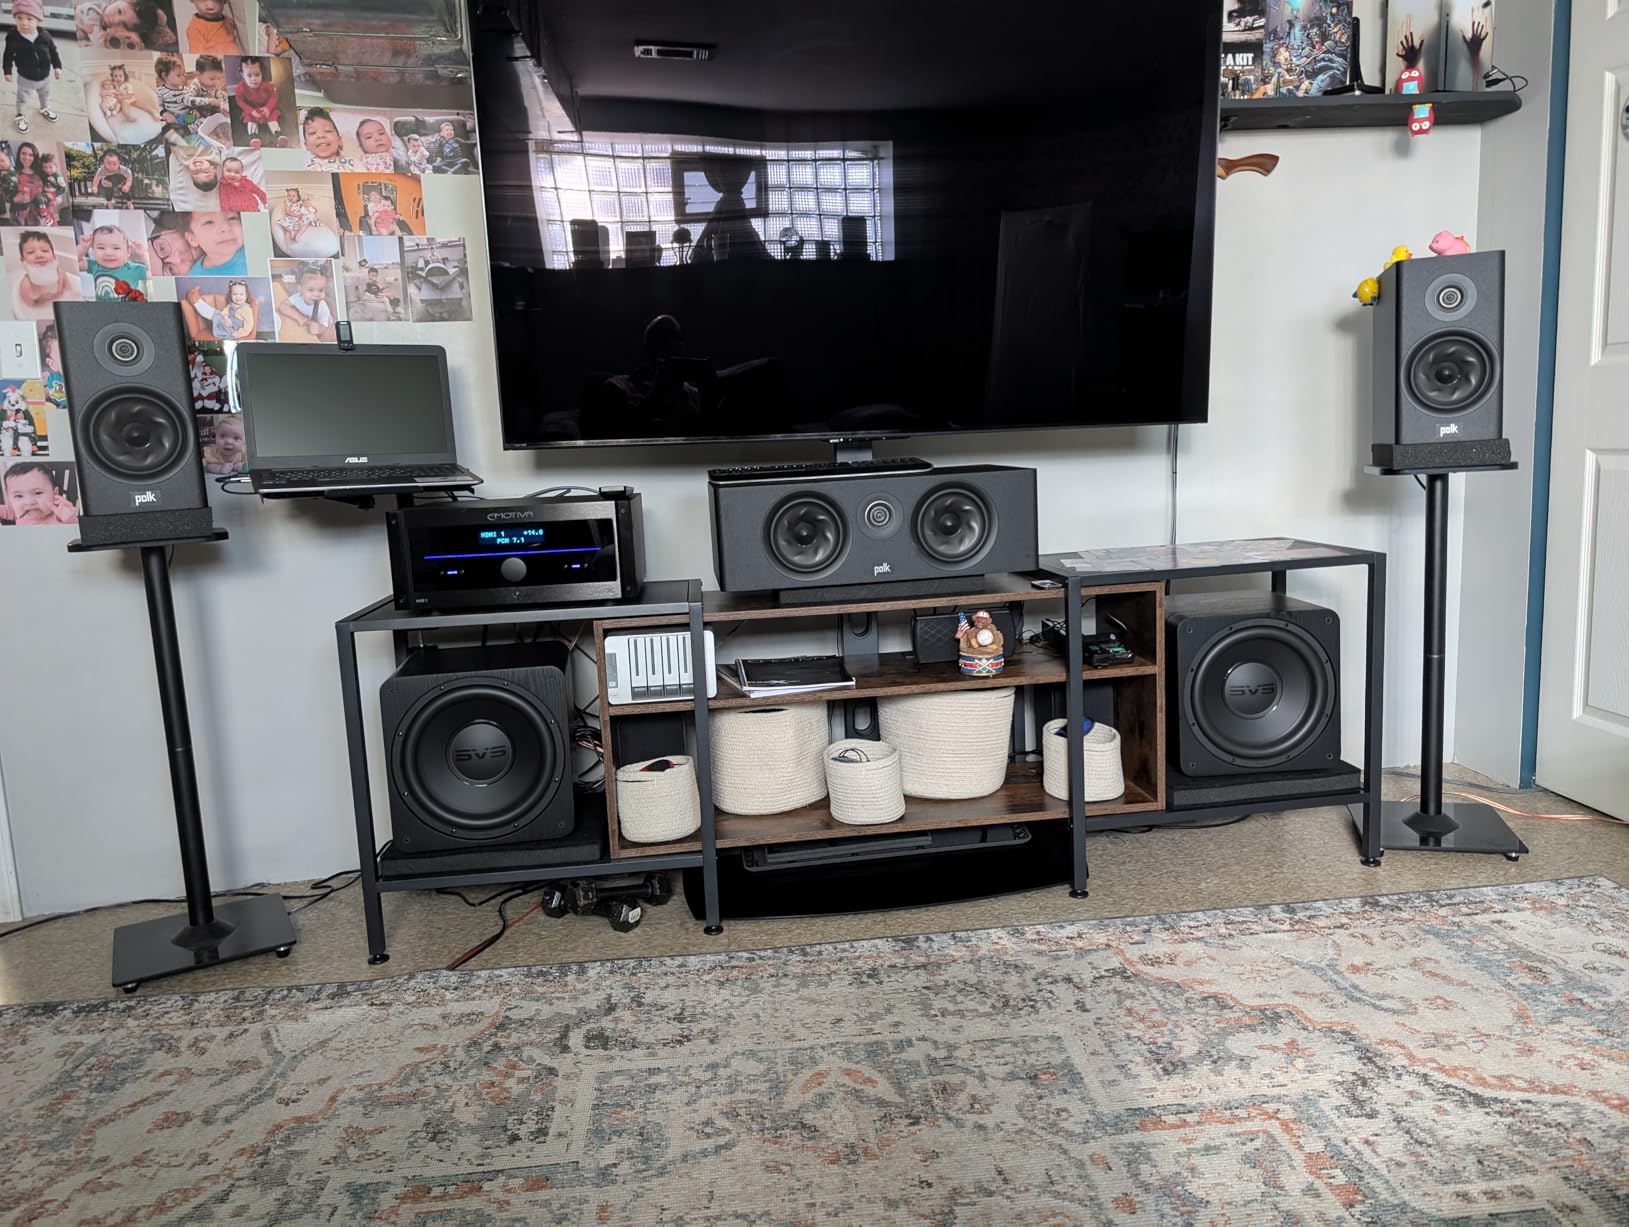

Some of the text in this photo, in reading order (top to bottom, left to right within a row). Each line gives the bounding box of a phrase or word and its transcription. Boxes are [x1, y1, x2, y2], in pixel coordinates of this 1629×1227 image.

[1226, 53, 1234, 66] A
[1235, 53, 1254, 66] KIT
[1440, 423, 1459, 438] polk
[344, 456, 368, 464] ASUS
[135, 490, 157, 506] polk
[496, 536, 525, 545] PCM 7.1
[874, 562, 891, 577] polk
[1230, 683, 1275, 696] SVS
[455, 745, 507, 761] SVS
